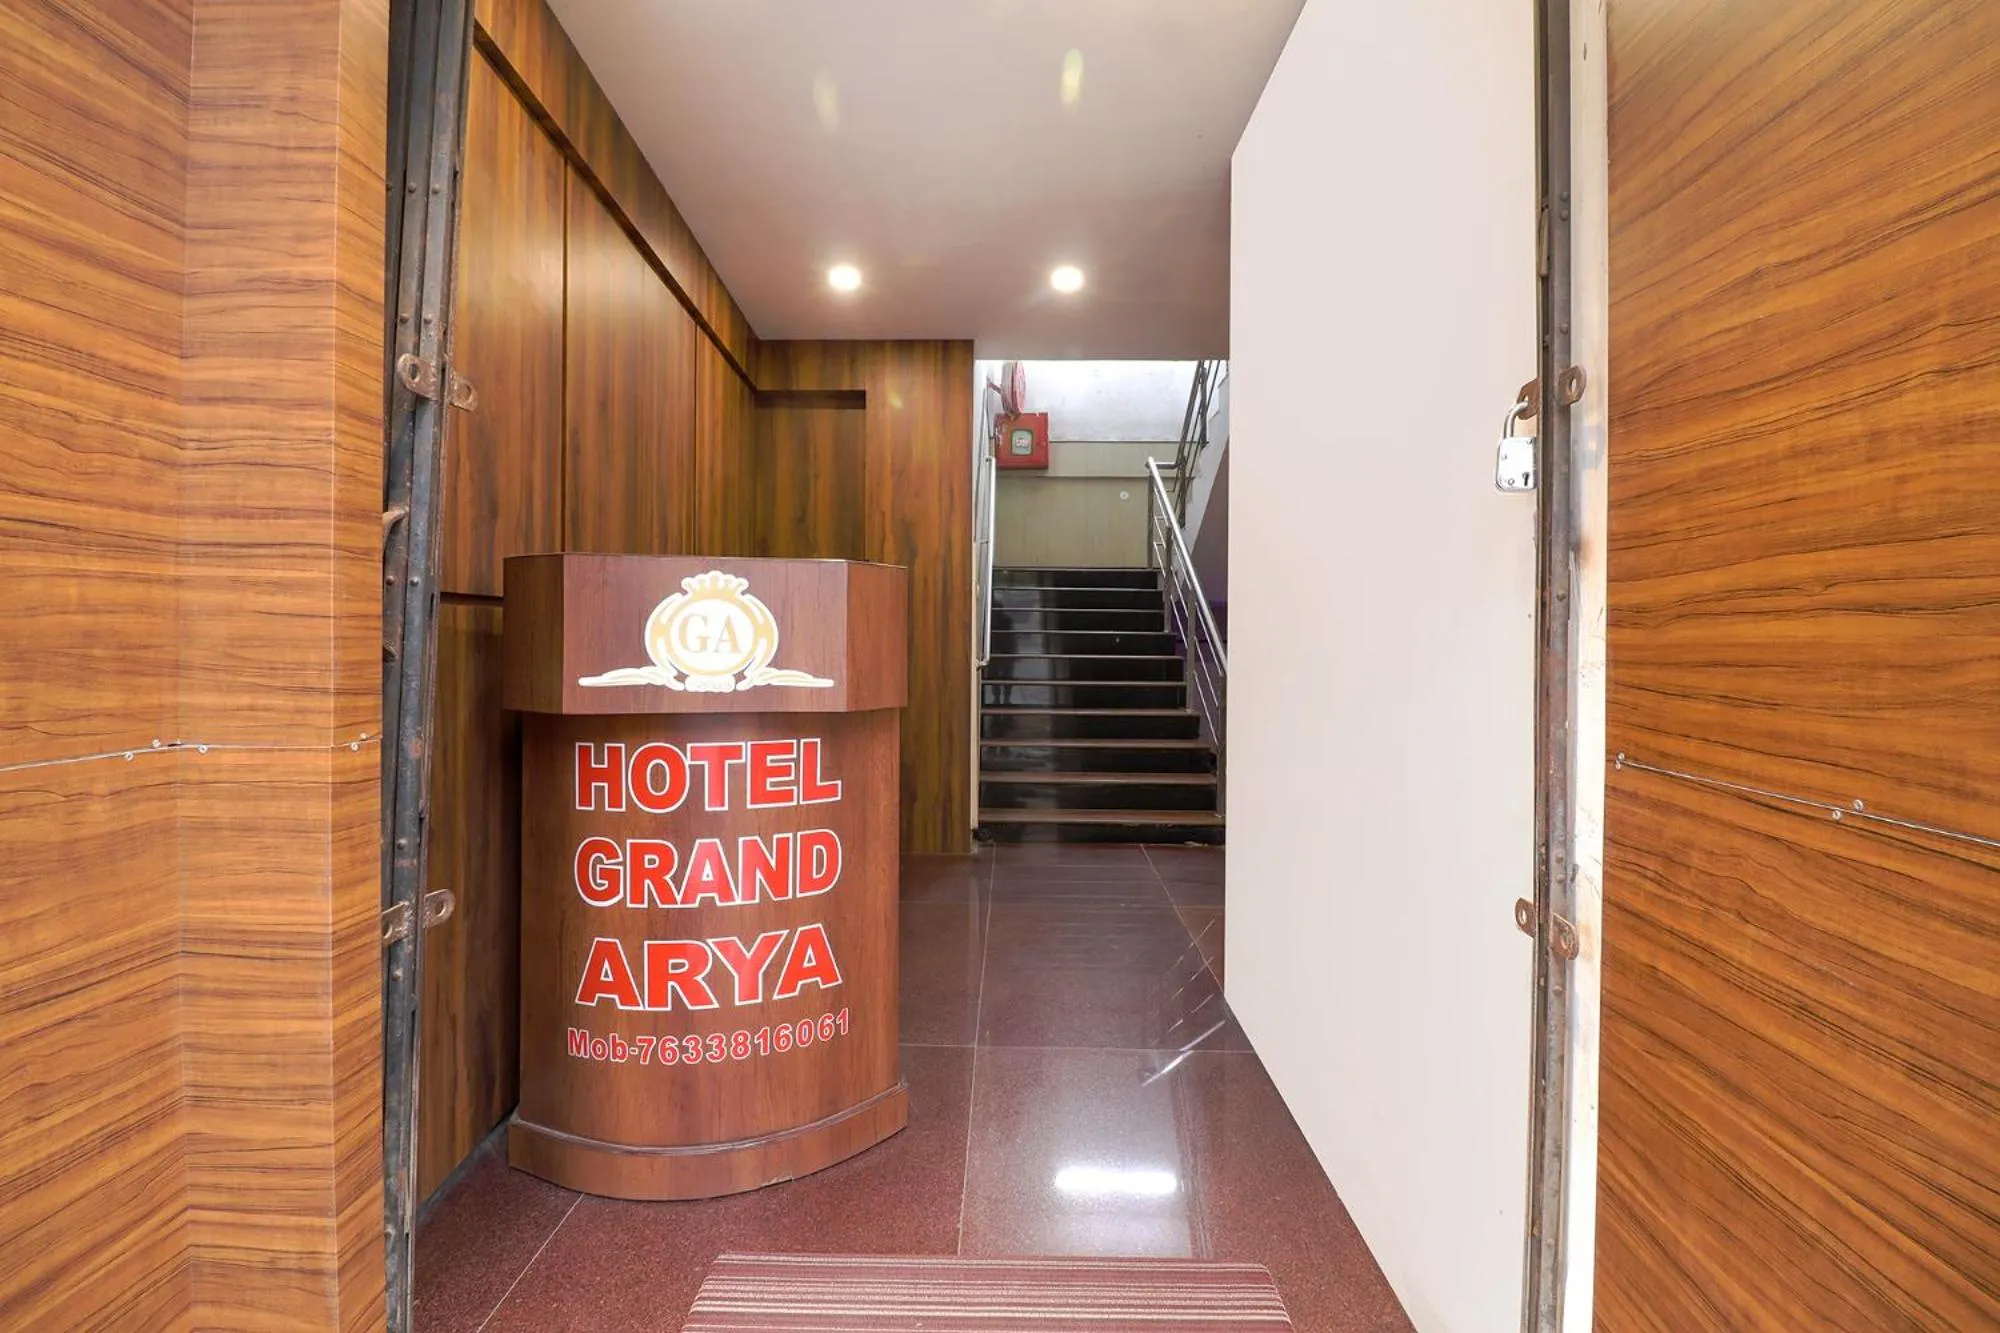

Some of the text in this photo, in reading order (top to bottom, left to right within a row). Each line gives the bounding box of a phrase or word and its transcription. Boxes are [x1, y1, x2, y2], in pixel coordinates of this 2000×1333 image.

[679, 614, 744, 656] GA
[575, 738, 842, 813] HOTEL
[575, 829, 842, 908] GRAND
[576, 924, 842, 1011] ARYA
[567, 1008, 850, 1065] Mob-7633816061
